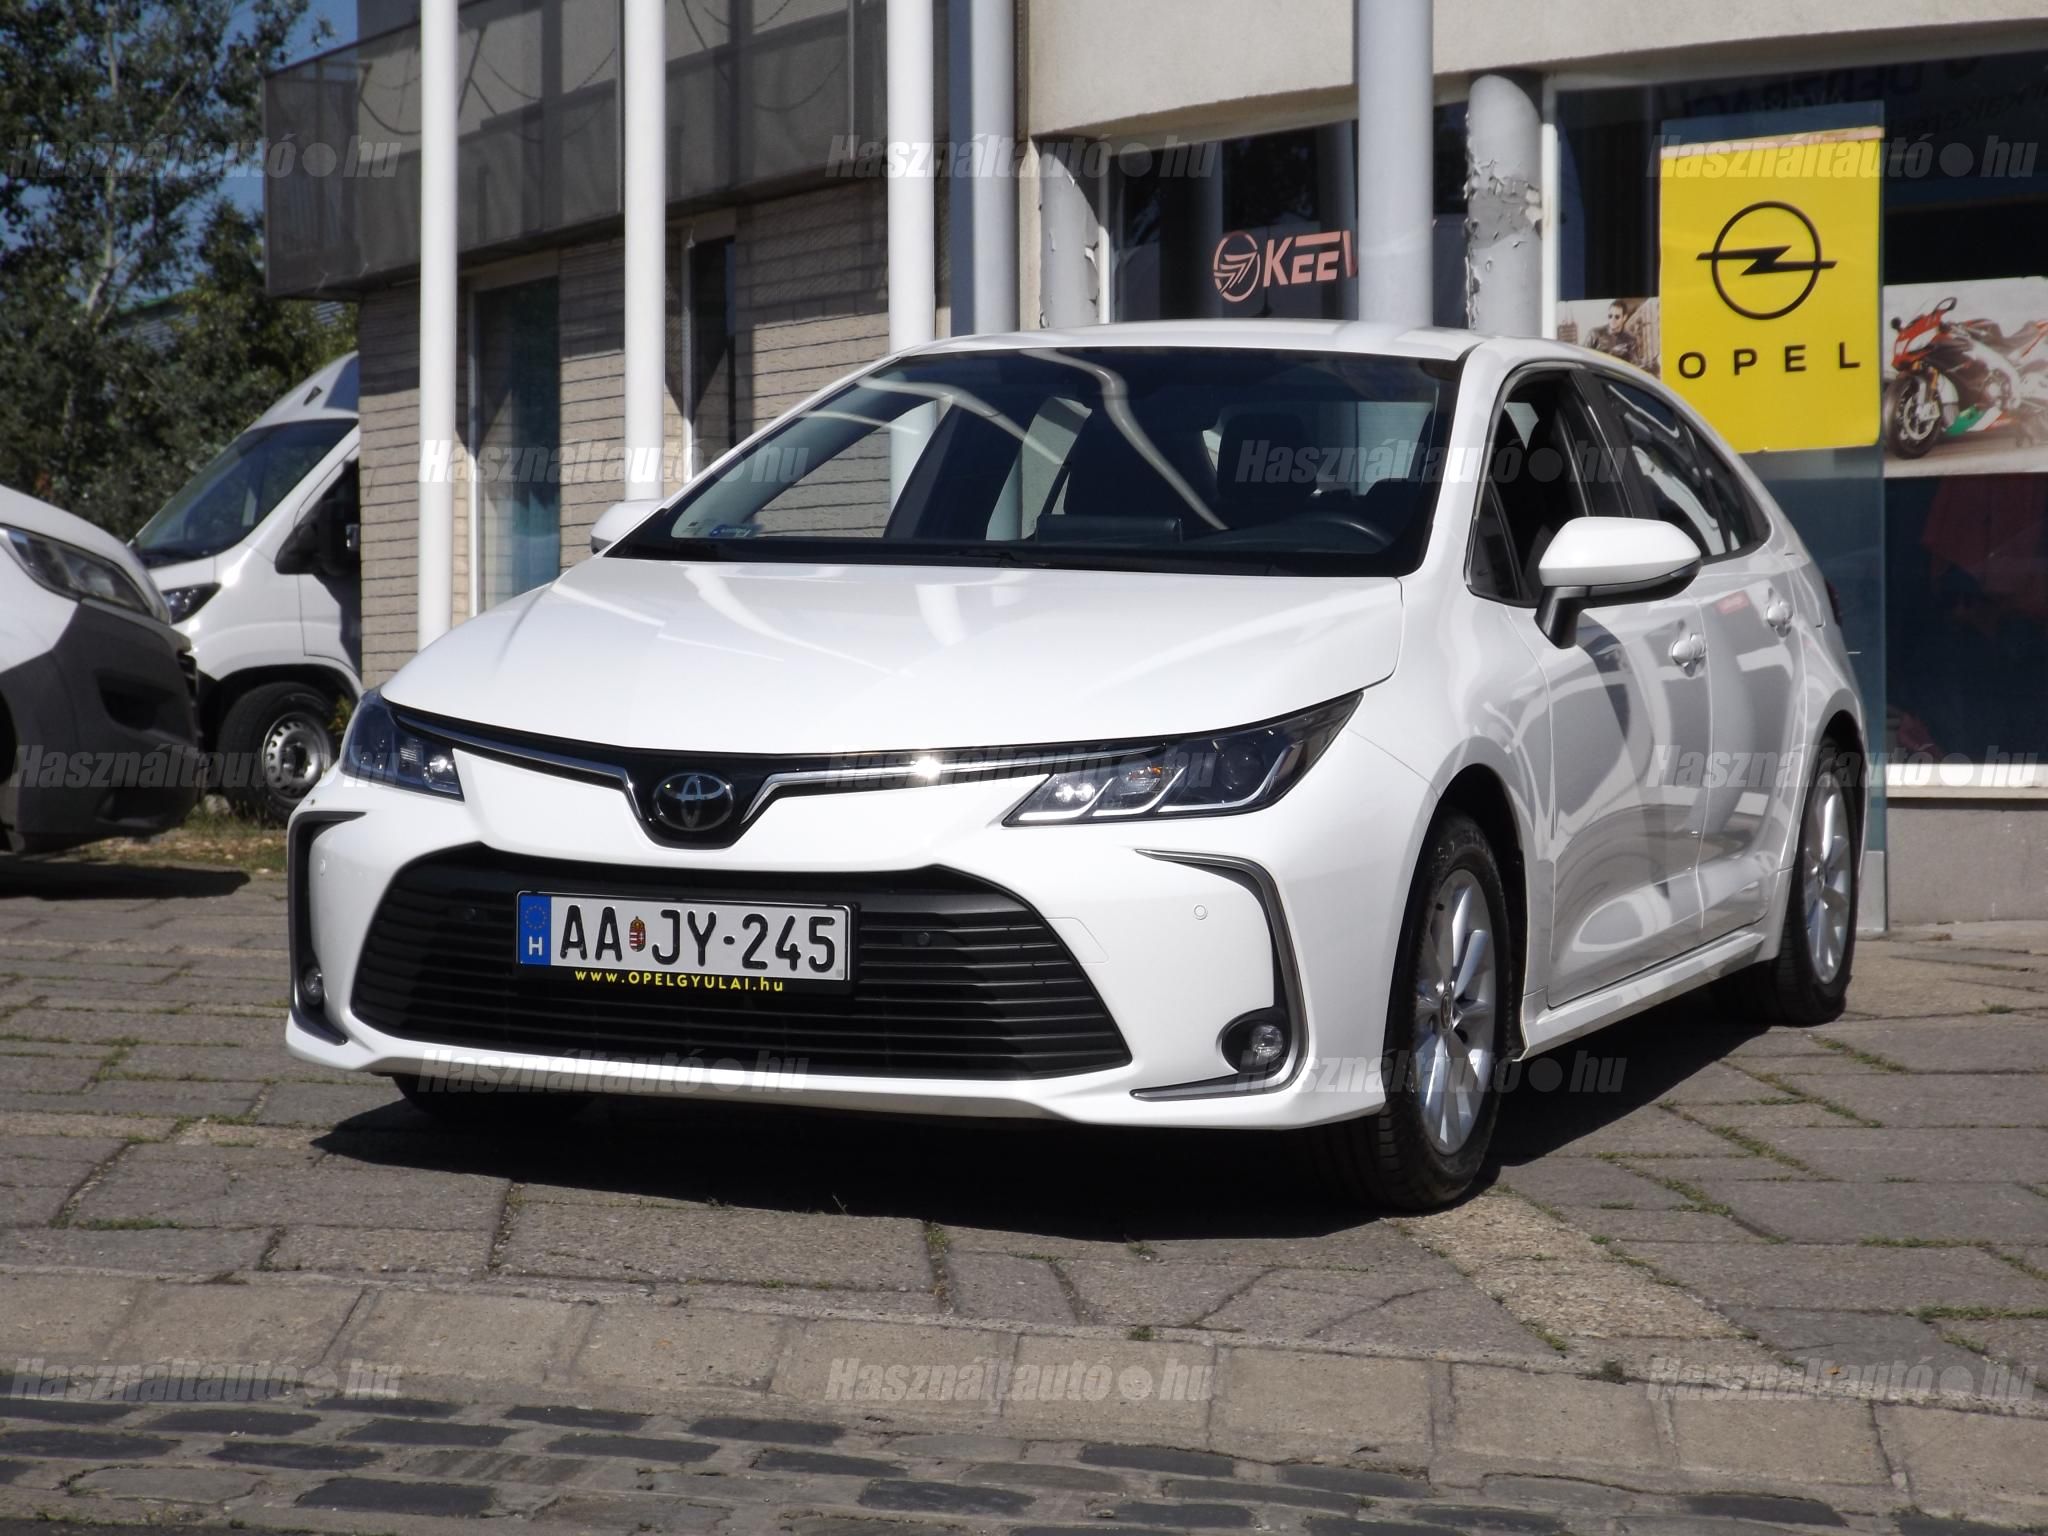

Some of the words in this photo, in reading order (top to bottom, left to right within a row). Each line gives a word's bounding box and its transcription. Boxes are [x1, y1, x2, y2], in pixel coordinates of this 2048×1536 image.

[1678, 342, 1861, 379] OPEL
[527, 936, 543, 957] H
[559, 904, 623, 962] AA
[651, 908, 836, 973] JY-245
[575, 969, 785, 992] www.OPELGYULAI.hu
